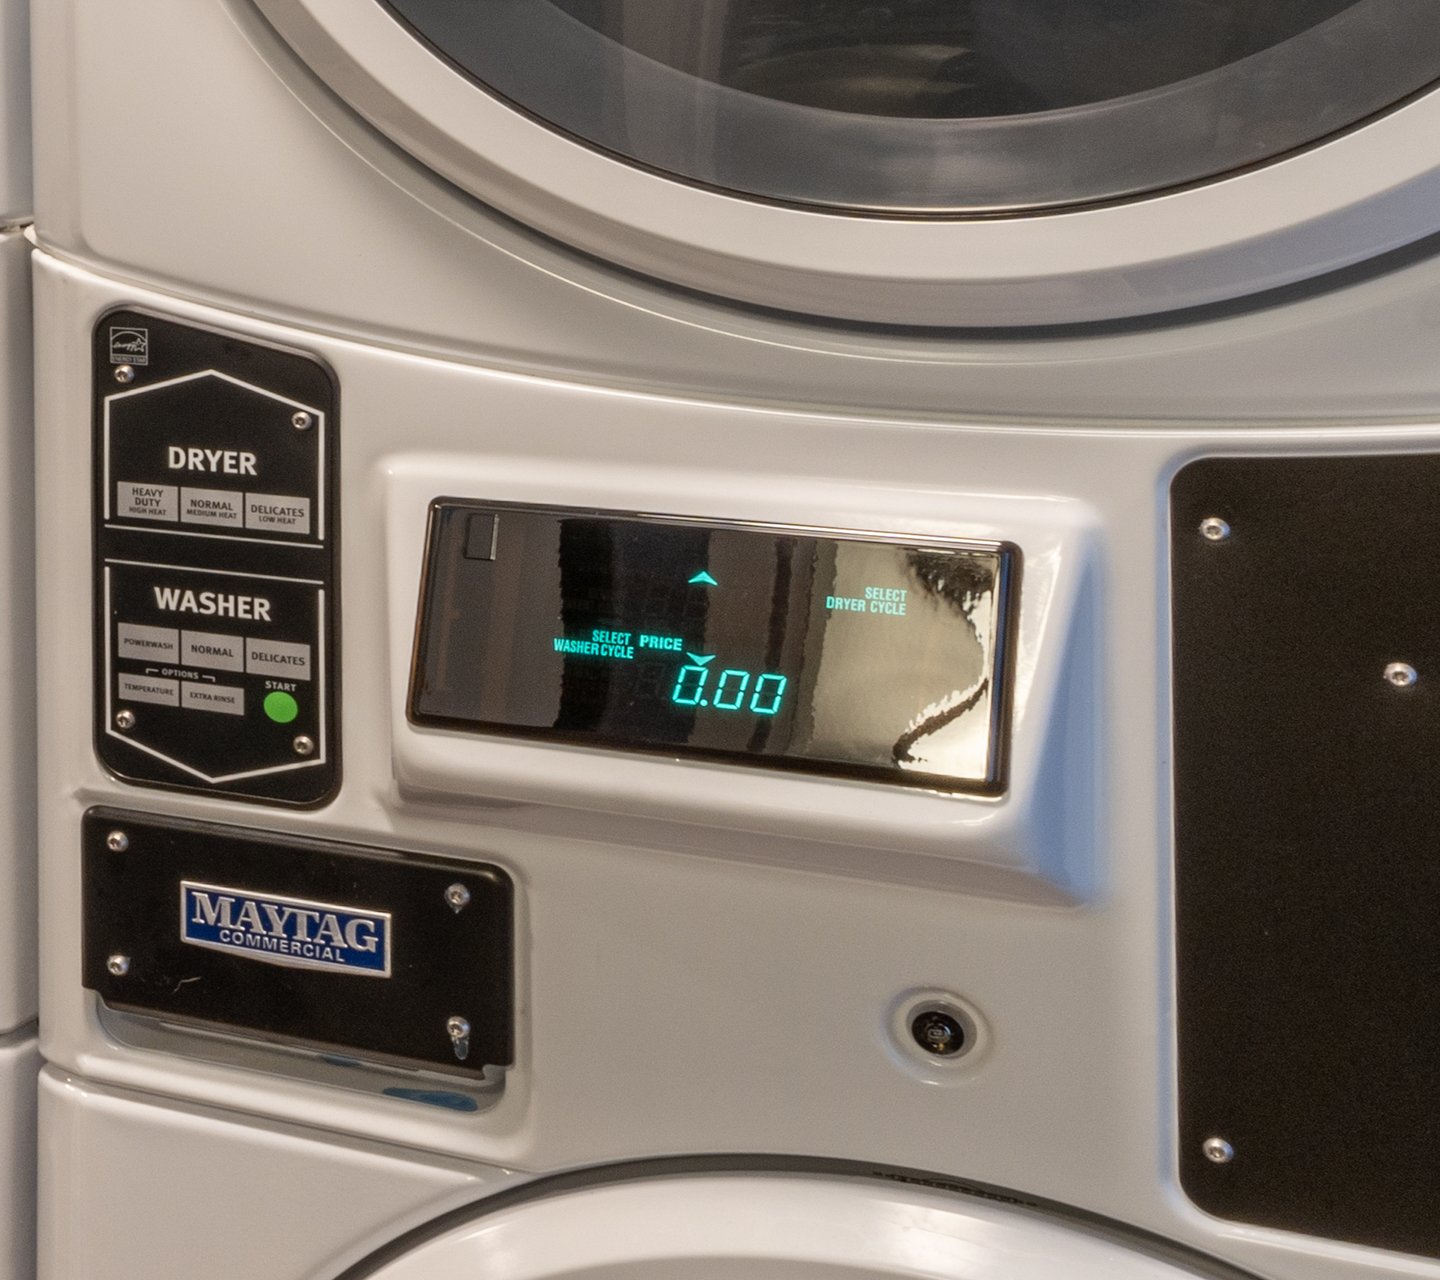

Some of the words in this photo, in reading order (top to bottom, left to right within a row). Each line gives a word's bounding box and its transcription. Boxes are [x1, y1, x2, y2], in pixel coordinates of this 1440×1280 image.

[168, 446, 257, 475] DRYER
[132, 487, 163, 498] HEAVY
[135, 497, 161, 507] DUTY
[190, 499, 234, 511] NORMAL
[129, 506, 146, 515] HIGH
[148, 508, 166, 516] HEAT
[187, 508, 217, 518] MEDIUM
[219, 511, 237, 519] HEAT
[251, 504, 304, 518] DELICATES
[258, 515, 275, 523] LOW
[277, 517, 296, 525] HEAT
[865, 587, 907, 602] SELECT
[154, 586, 272, 621] WASHER
[826, 596, 866, 613] DRYER
[870, 600, 907, 616] CYCLE
[124, 637, 174, 650] POWERWASH
[592, 629, 632, 646] SELECT
[639, 634, 683, 651] PRICE
[191, 644, 234, 658] NORMAL
[553, 638, 599, 656] WASHER
[600, 644, 634, 659] CYCLE
[251, 651, 305, 666] DELICATES
[161, 668, 199, 680] OPTIONS
[124, 683, 174, 696] TEMPERATURE
[265, 680, 297, 692] START
[672, 665, 787, 716] 0.00
[190, 691, 212, 701] EXTRA
[214, 694, 235, 704] RINSE
[191, 891, 379, 954] MAYTAG
[219, 929, 345, 962] COMMERCIAL
